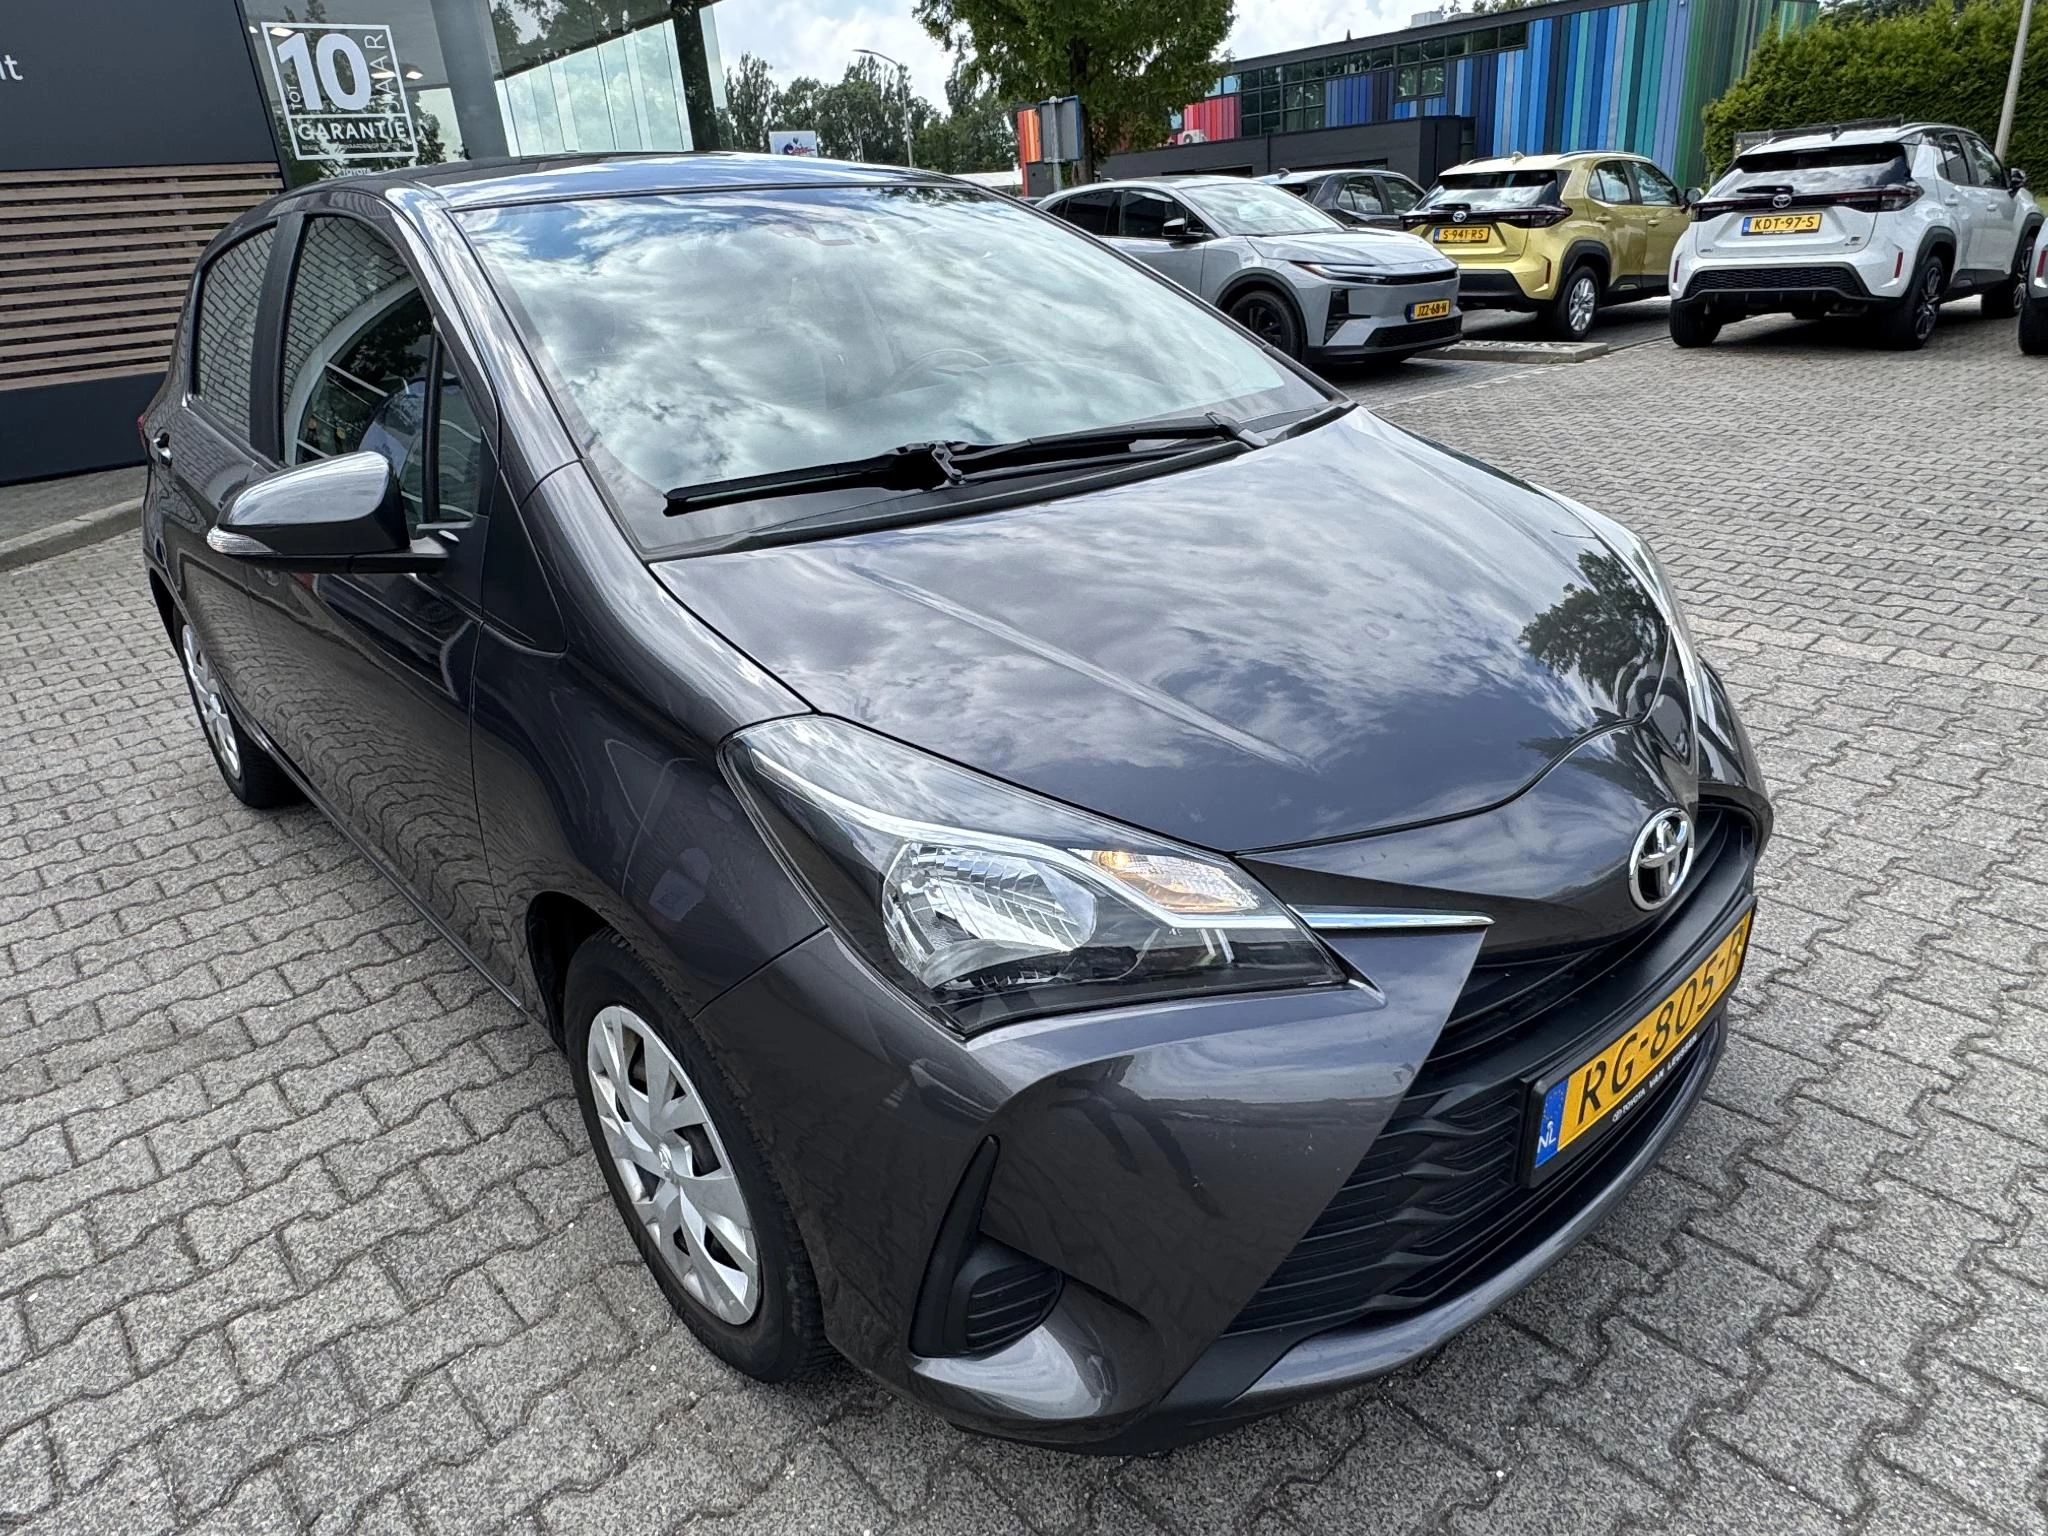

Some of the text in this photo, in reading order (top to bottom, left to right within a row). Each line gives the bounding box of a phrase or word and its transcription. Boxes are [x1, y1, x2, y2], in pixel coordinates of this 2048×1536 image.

[0, 54, 24, 81] t
[277, 32, 372, 110] 10
[363, 34, 401, 110] JAAR
[286, 83, 303, 111] TOT
[298, 121, 407, 141] GARANTIE
[1754, 216, 1815, 230] KDT-97-S
[1578, 926, 1744, 1126] RG-805-R
[1537, 1124, 1557, 1154] NL
